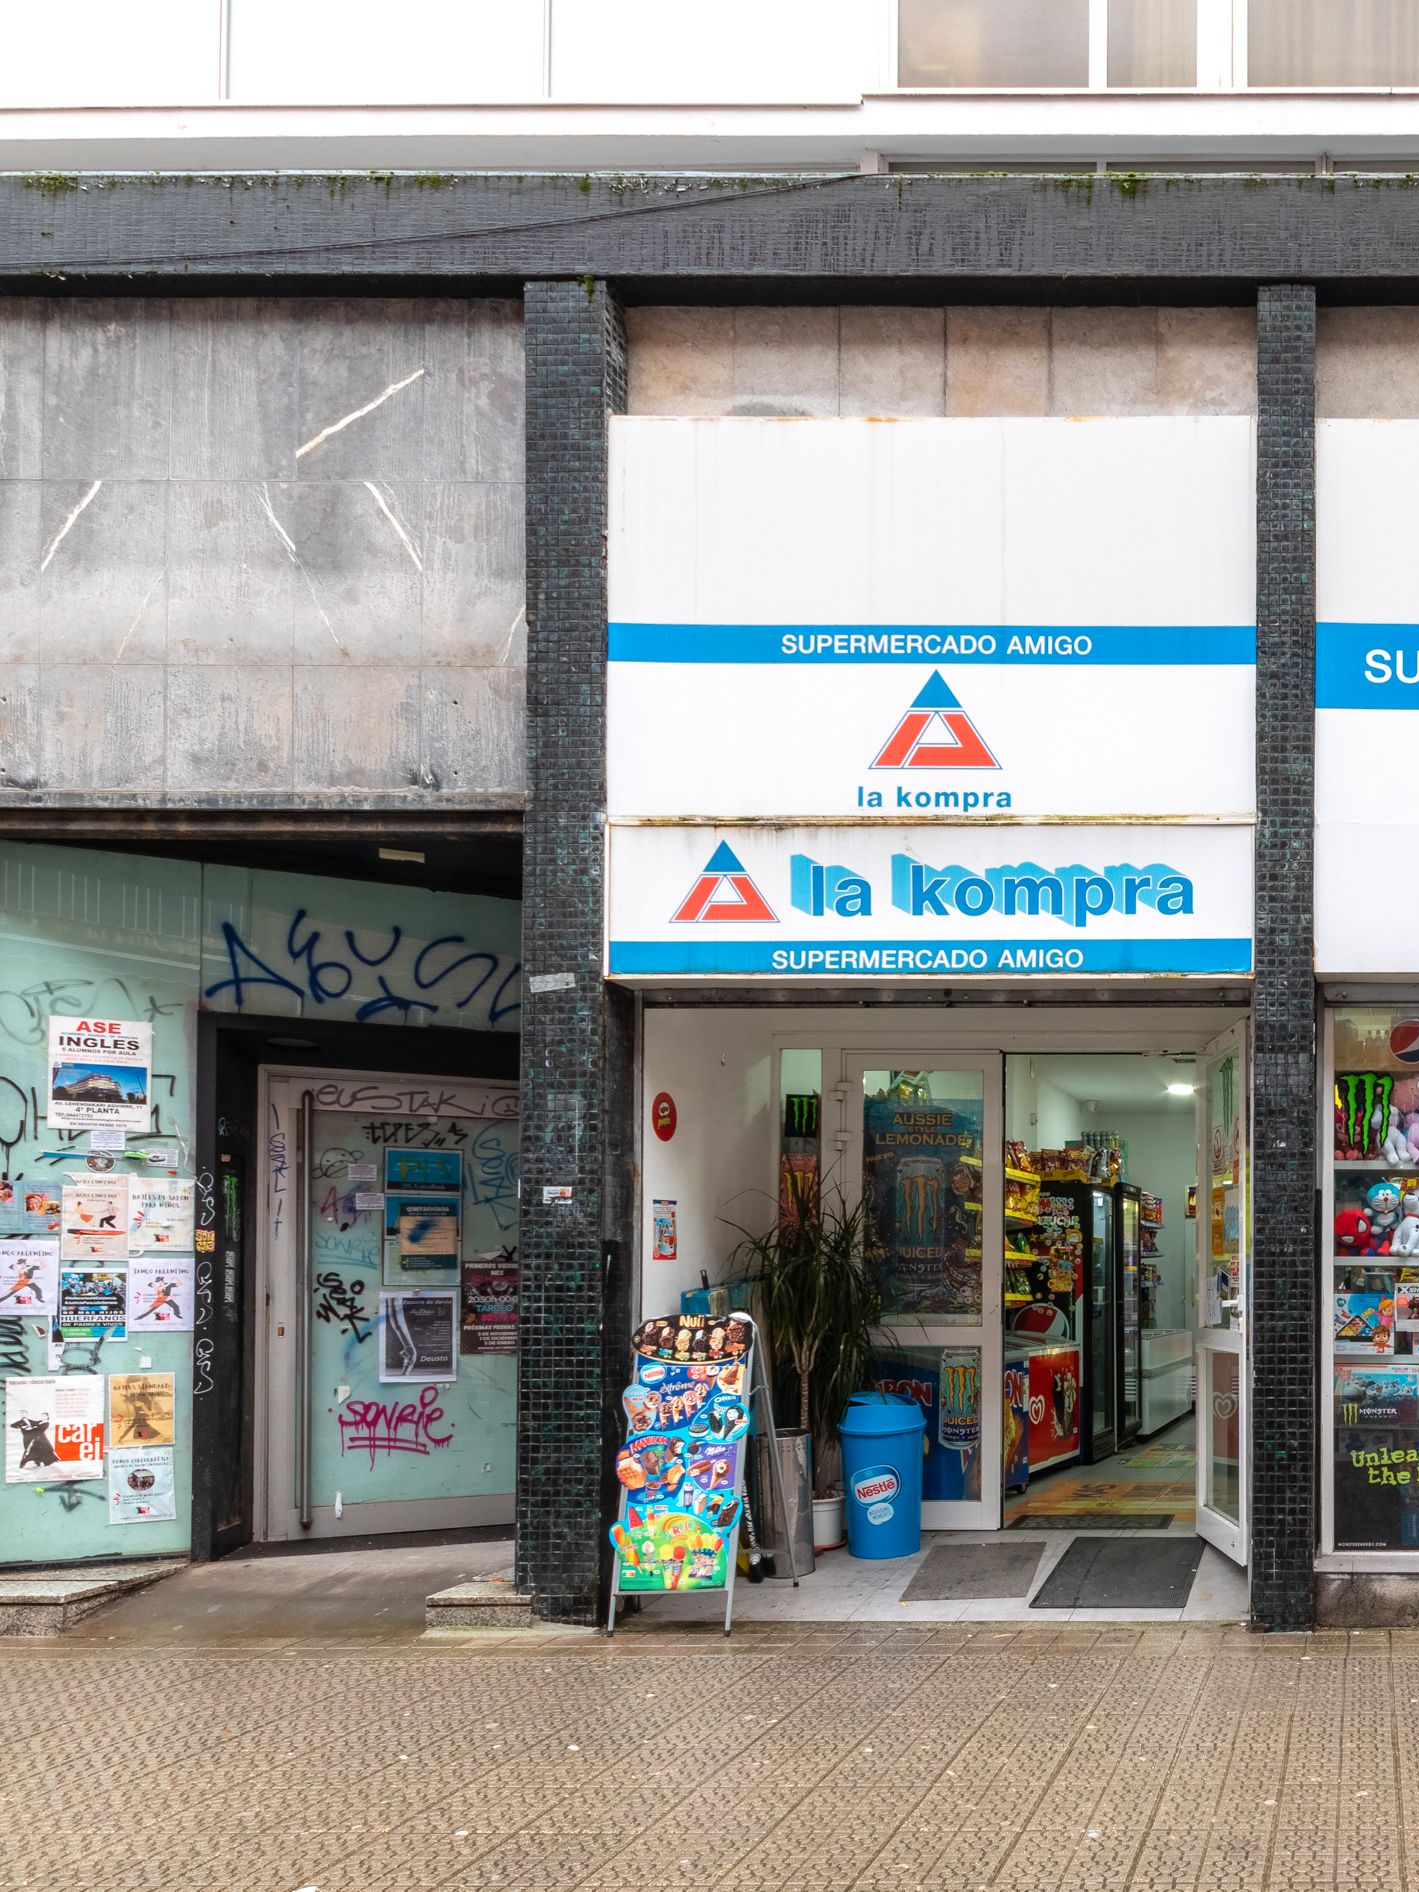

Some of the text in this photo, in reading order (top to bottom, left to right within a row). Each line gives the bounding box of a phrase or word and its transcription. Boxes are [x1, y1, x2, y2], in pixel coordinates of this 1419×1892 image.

[780, 633, 1093, 656] SUPERMERCADO AMIGO
[857, 786, 1012, 812] la kompra
[798, 856, 1195, 928] la kompra
[772, 949, 1084, 970] SUPERMERCADO AMIGO
[76, 1021, 121, 1034] ASE
[59, 1036, 140, 1050] INGLES
[892, 1113, 953, 1126] AUSSIE
[875, 1134, 968, 1146] LEMONADE
[1368, 1466, 1411, 1485] the
